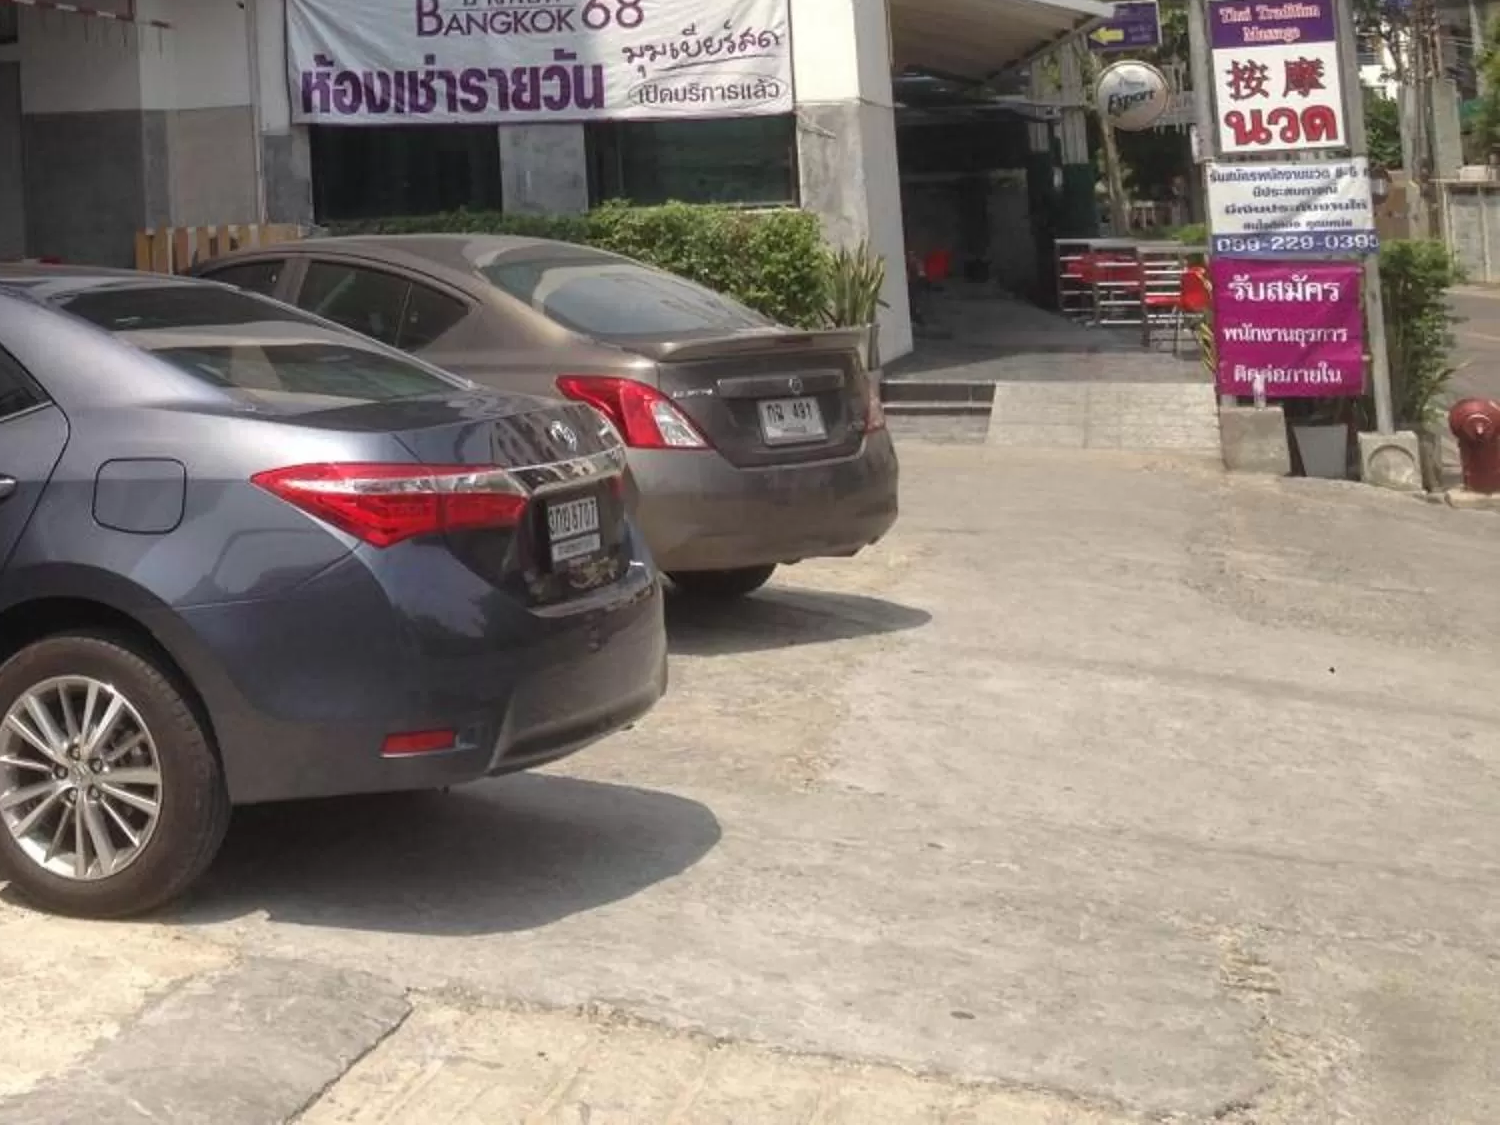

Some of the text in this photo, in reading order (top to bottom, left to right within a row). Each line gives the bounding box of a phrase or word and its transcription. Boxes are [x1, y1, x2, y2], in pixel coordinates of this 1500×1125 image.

[301, 47, 606, 115] ห้องเช่ารายวัน
[637, 78, 781, 105] เปิดบริการแล้ว
[1225, 55, 1327, 101] 按摩
[1223, 104, 1339, 146] นวด
[1227, 274, 1341, 303] รับสมัคร
[1223, 322, 1348, 347] พนักงานธุรการ
